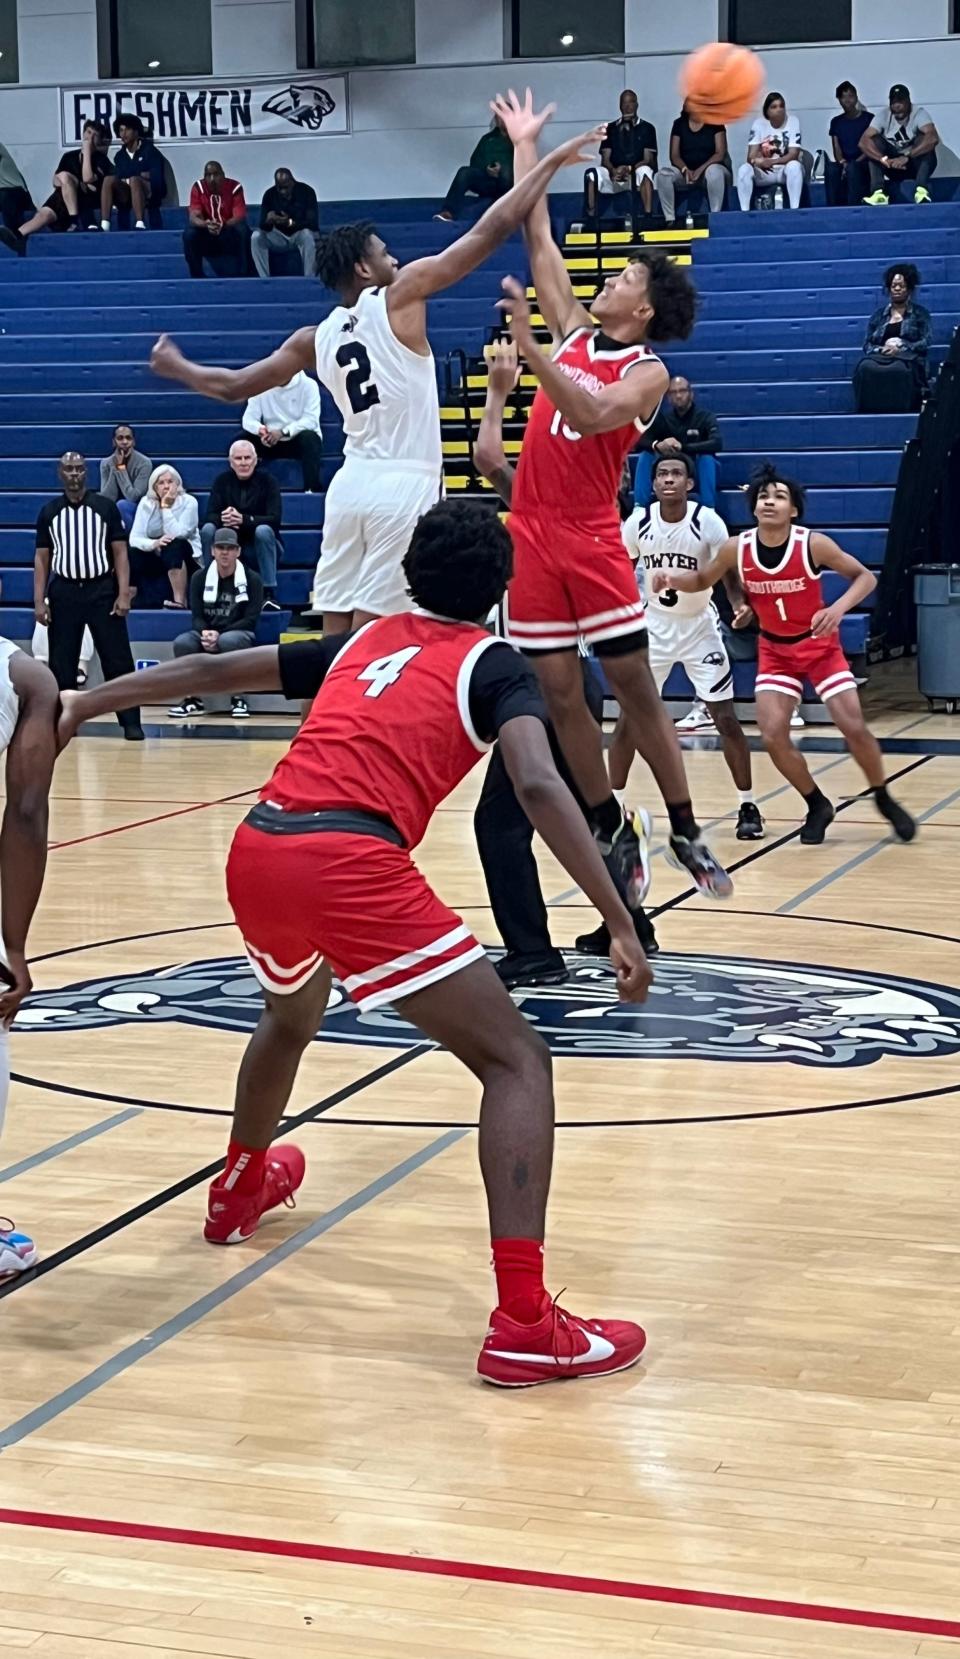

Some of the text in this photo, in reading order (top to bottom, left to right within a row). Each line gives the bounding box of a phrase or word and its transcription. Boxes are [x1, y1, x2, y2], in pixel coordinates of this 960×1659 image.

[335, 341, 381, 414] 2
[643, 552, 698, 571] DWYER
[746, 576, 807, 594] SOUTHRIDGE
[775, 597, 788, 622] 1
[354, 644, 424, 699] 4
